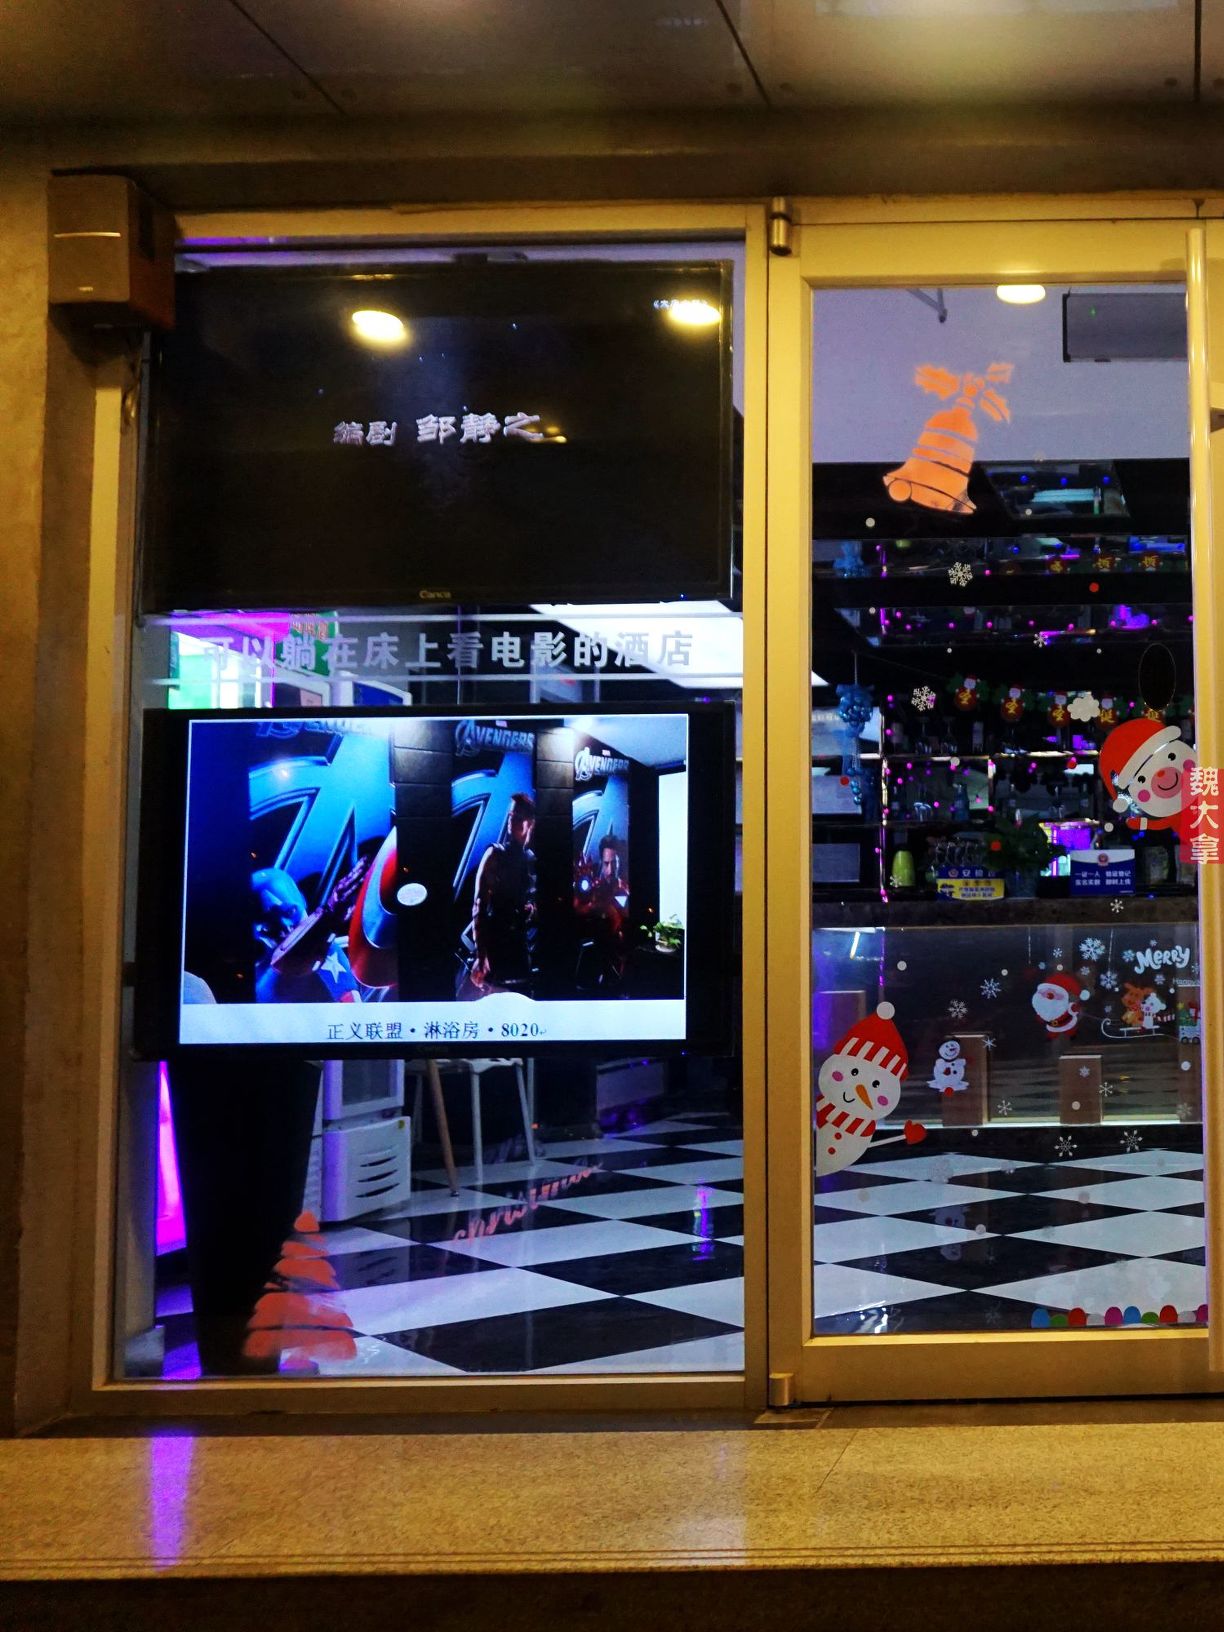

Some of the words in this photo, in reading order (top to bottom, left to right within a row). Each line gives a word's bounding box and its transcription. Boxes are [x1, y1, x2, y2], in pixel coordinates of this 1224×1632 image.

[333, 421, 398, 446] 编剧
[415, 411, 546, 445] 邹静之
[202, 631, 693, 671] 可以躺在床上看电影的酒店
